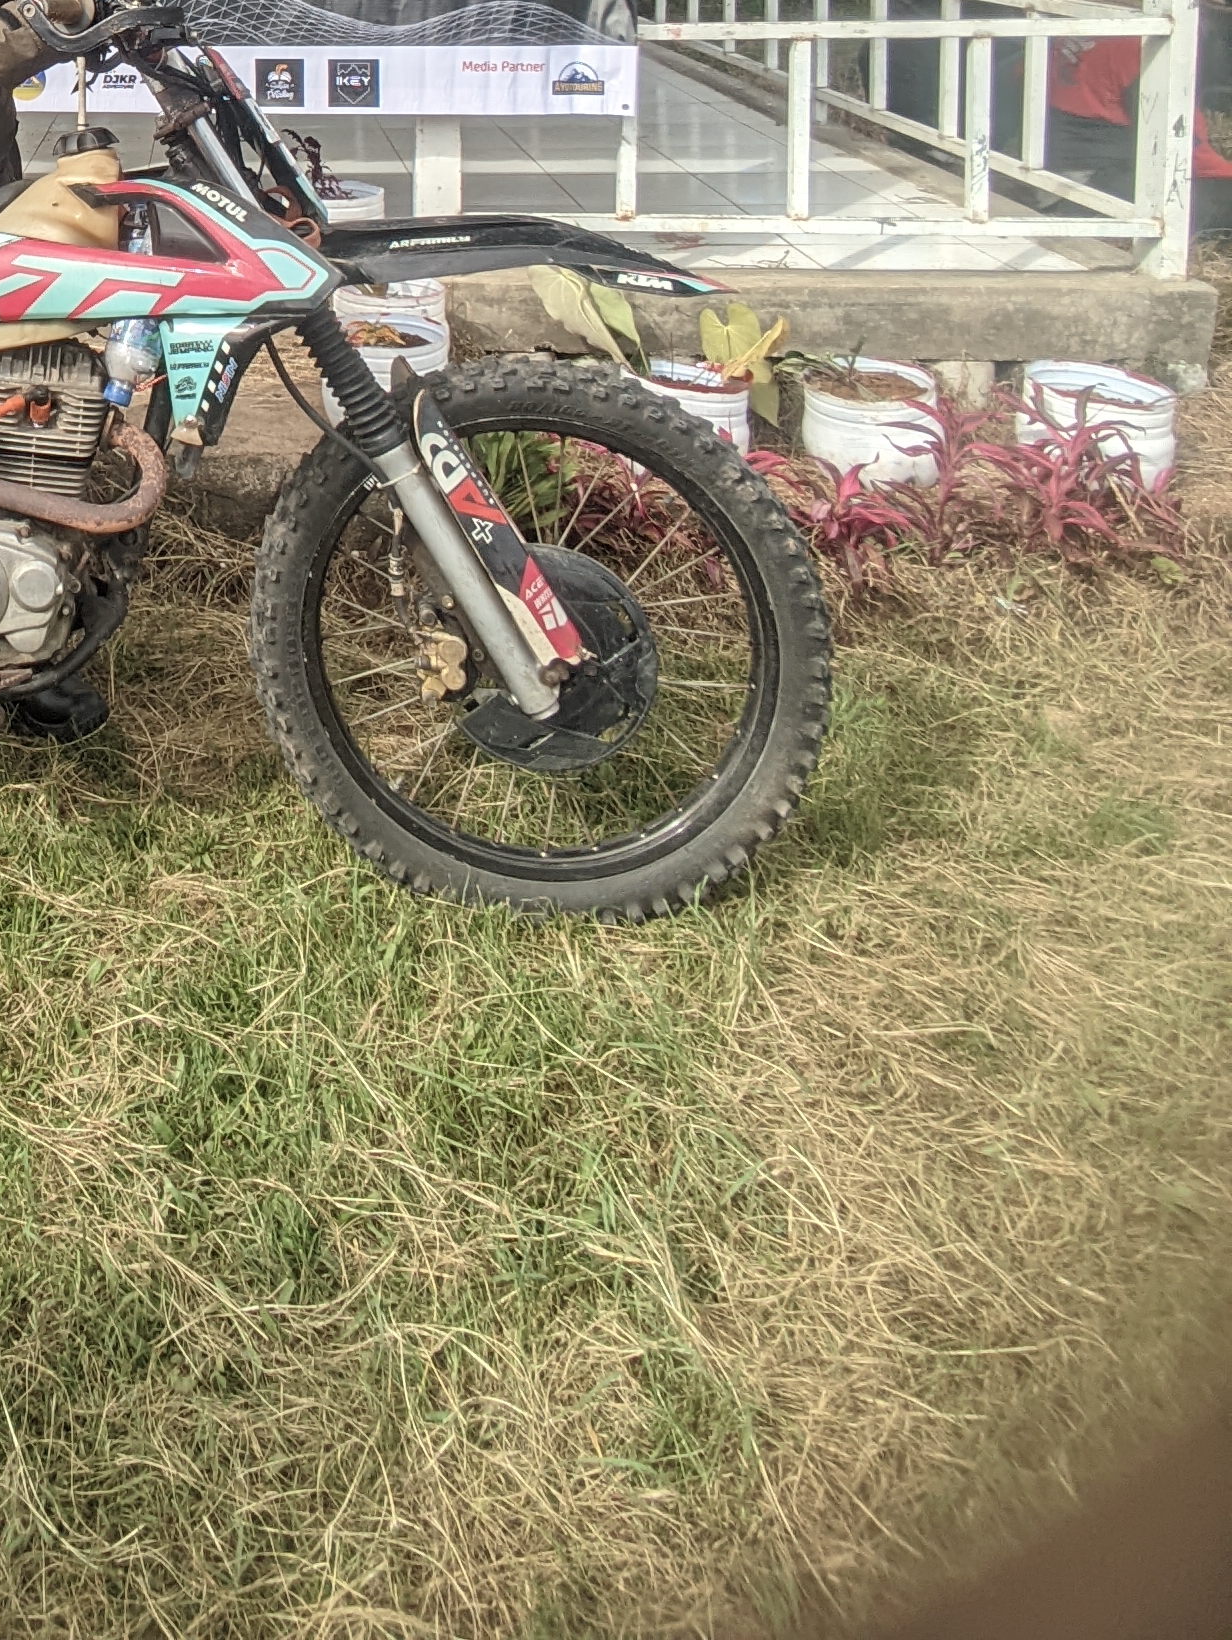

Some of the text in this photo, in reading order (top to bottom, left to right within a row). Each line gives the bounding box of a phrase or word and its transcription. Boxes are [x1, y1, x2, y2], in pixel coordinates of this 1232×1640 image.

[461, 60, 546, 72] Media Partner
[103, 74, 137, 84] DJKR
[189, 182, 248, 223] MOTUL
[616, 272, 674, 291] KTM
